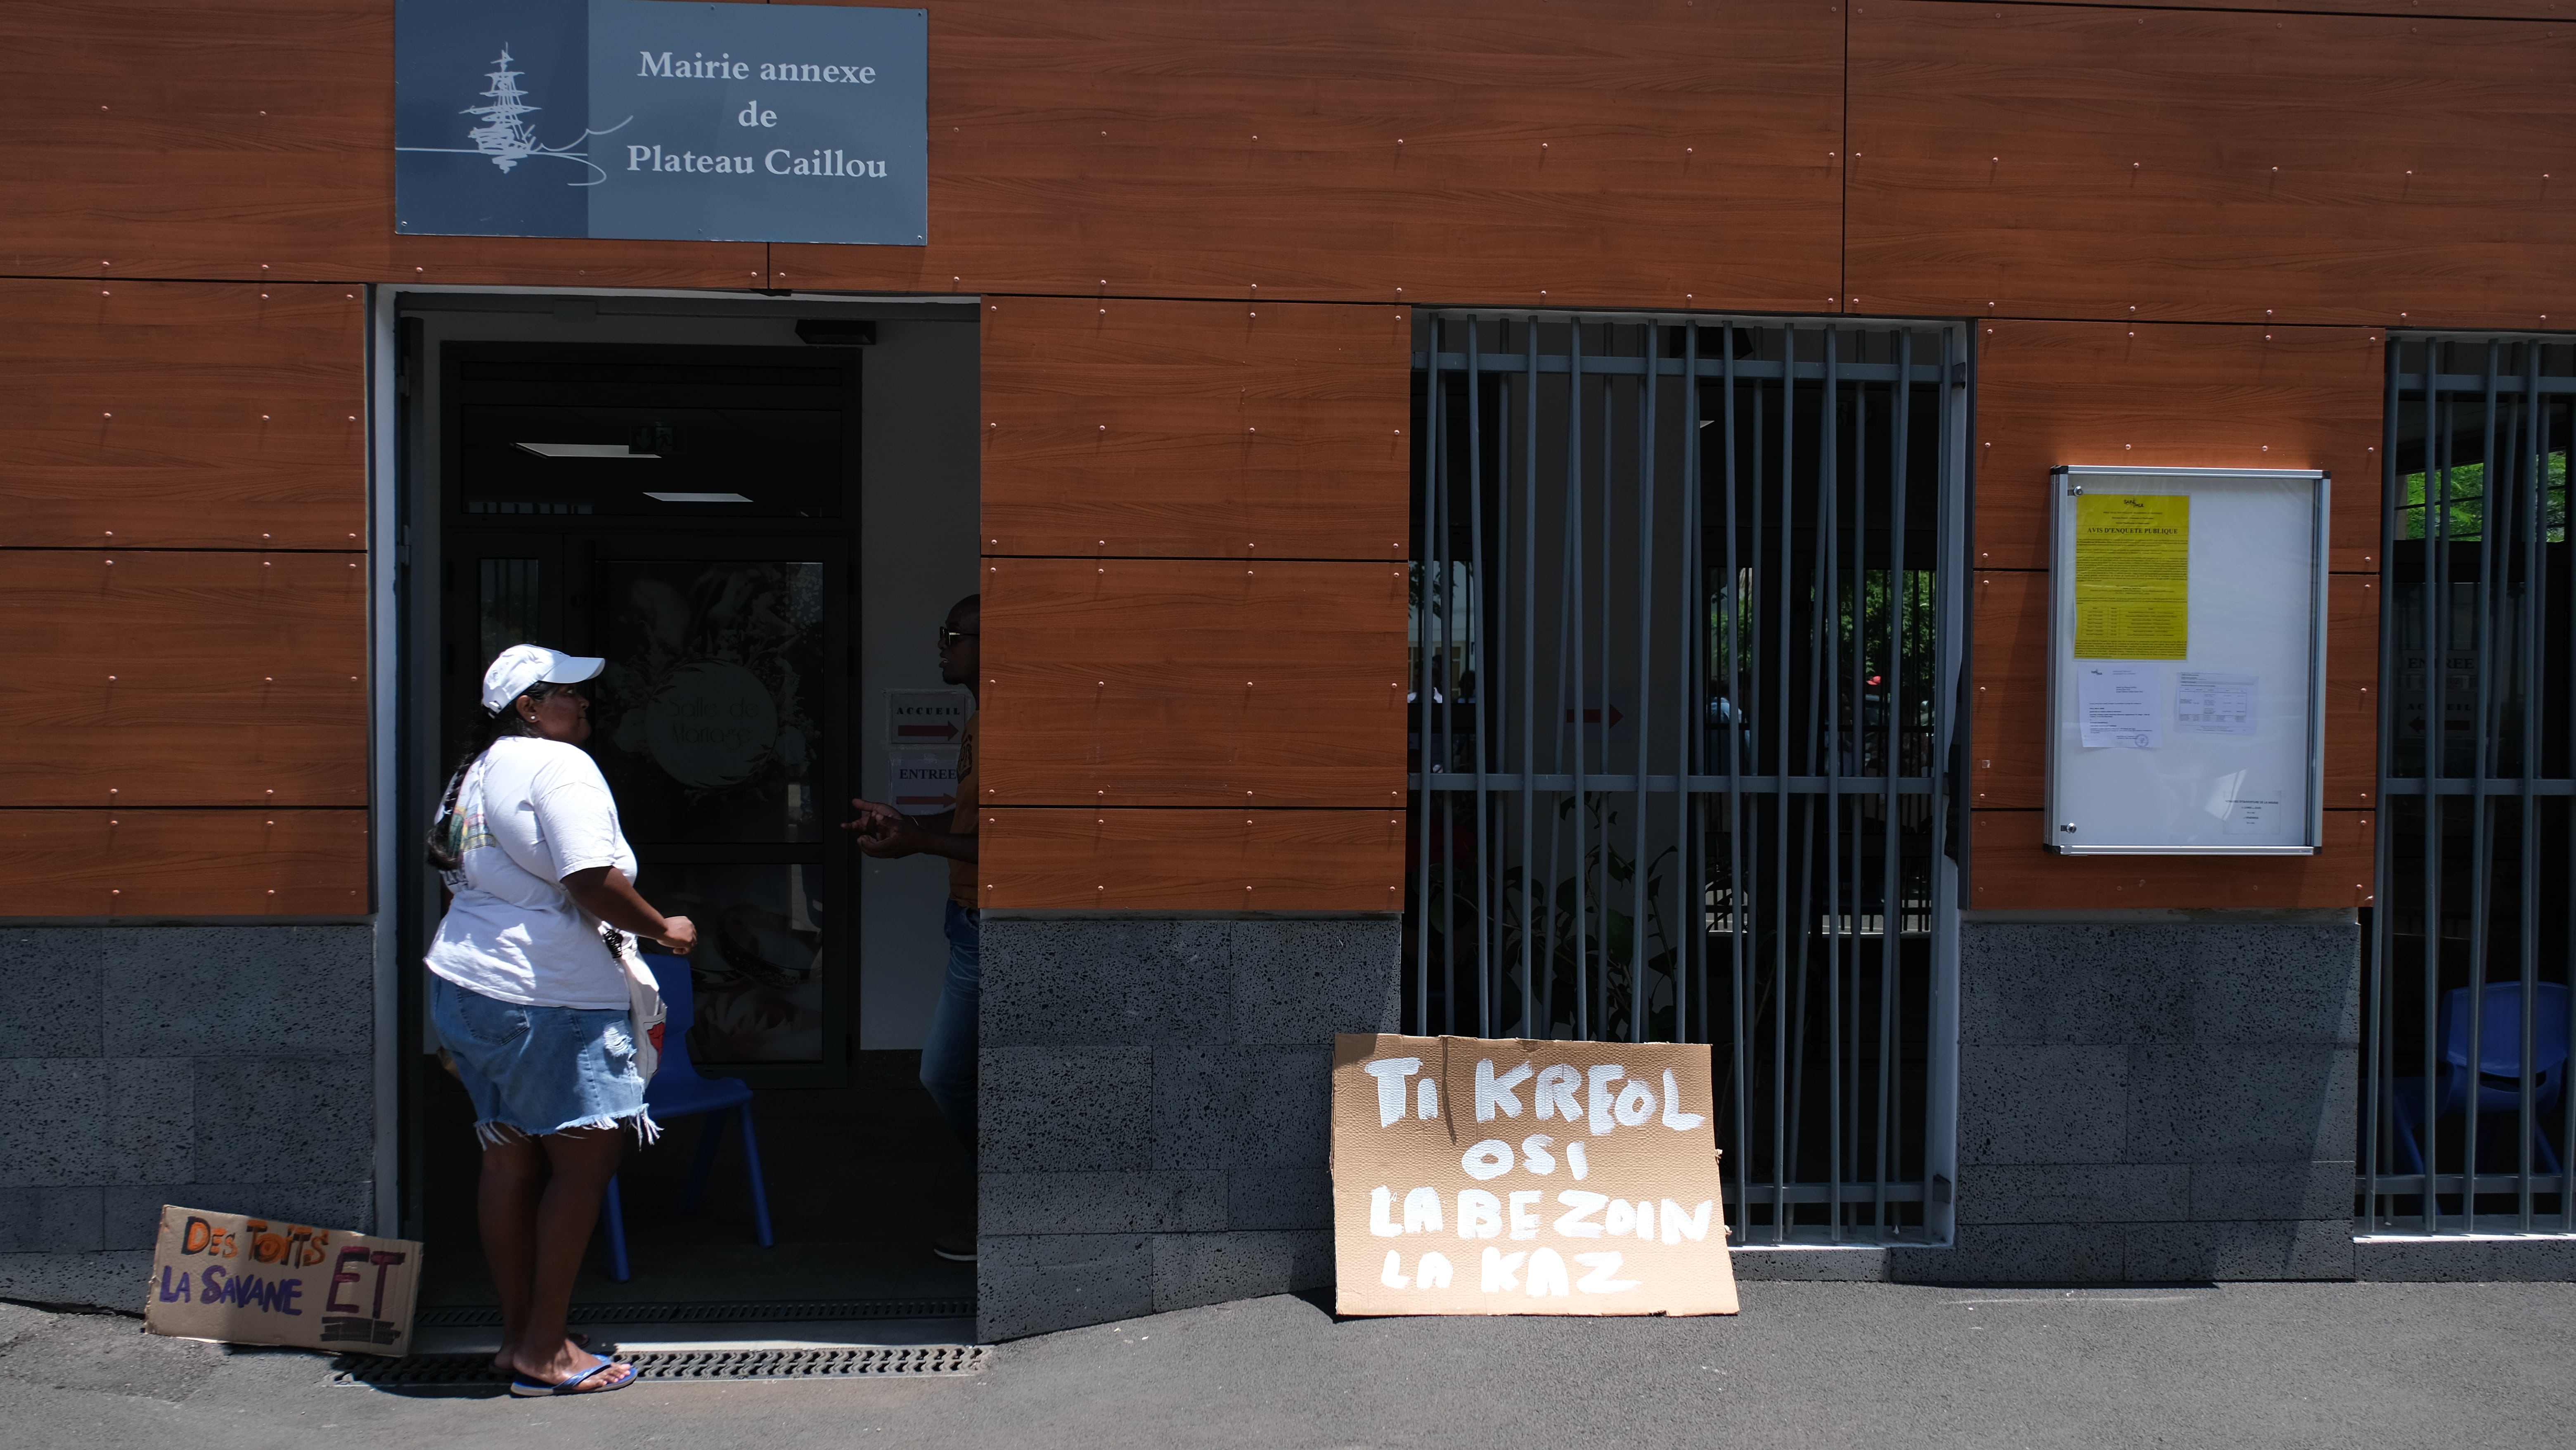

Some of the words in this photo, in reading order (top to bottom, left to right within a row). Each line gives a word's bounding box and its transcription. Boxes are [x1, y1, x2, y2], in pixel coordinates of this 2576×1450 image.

[637, 51, 749, 80] Mairie
[760, 63, 876, 84] annexe
[738, 100, 777, 128] de
[627, 145, 755, 174] Plateau
[765, 149, 888, 178] Caillou
[2408, 658, 2474, 668] ENREE
[667, 697, 717, 718] Salle
[729, 697, 759, 718] de
[896, 707, 960, 715] ACCUEIL
[673, 723, 751, 750] Mariage
[900, 769, 957, 779] ENTREE
[1475, 1058, 1707, 1136] KREOL
[1461, 1134, 1589, 1180] OSI
[1369, 1185, 1443, 1237] LA
[326, 1246, 406, 1319] ET
[1381, 1249, 1454, 1290] LA
[1481, 1246, 1642, 1297] KAZ
[159, 1265, 191, 1303] LA
[200, 1265, 303, 1316] SAVANE
